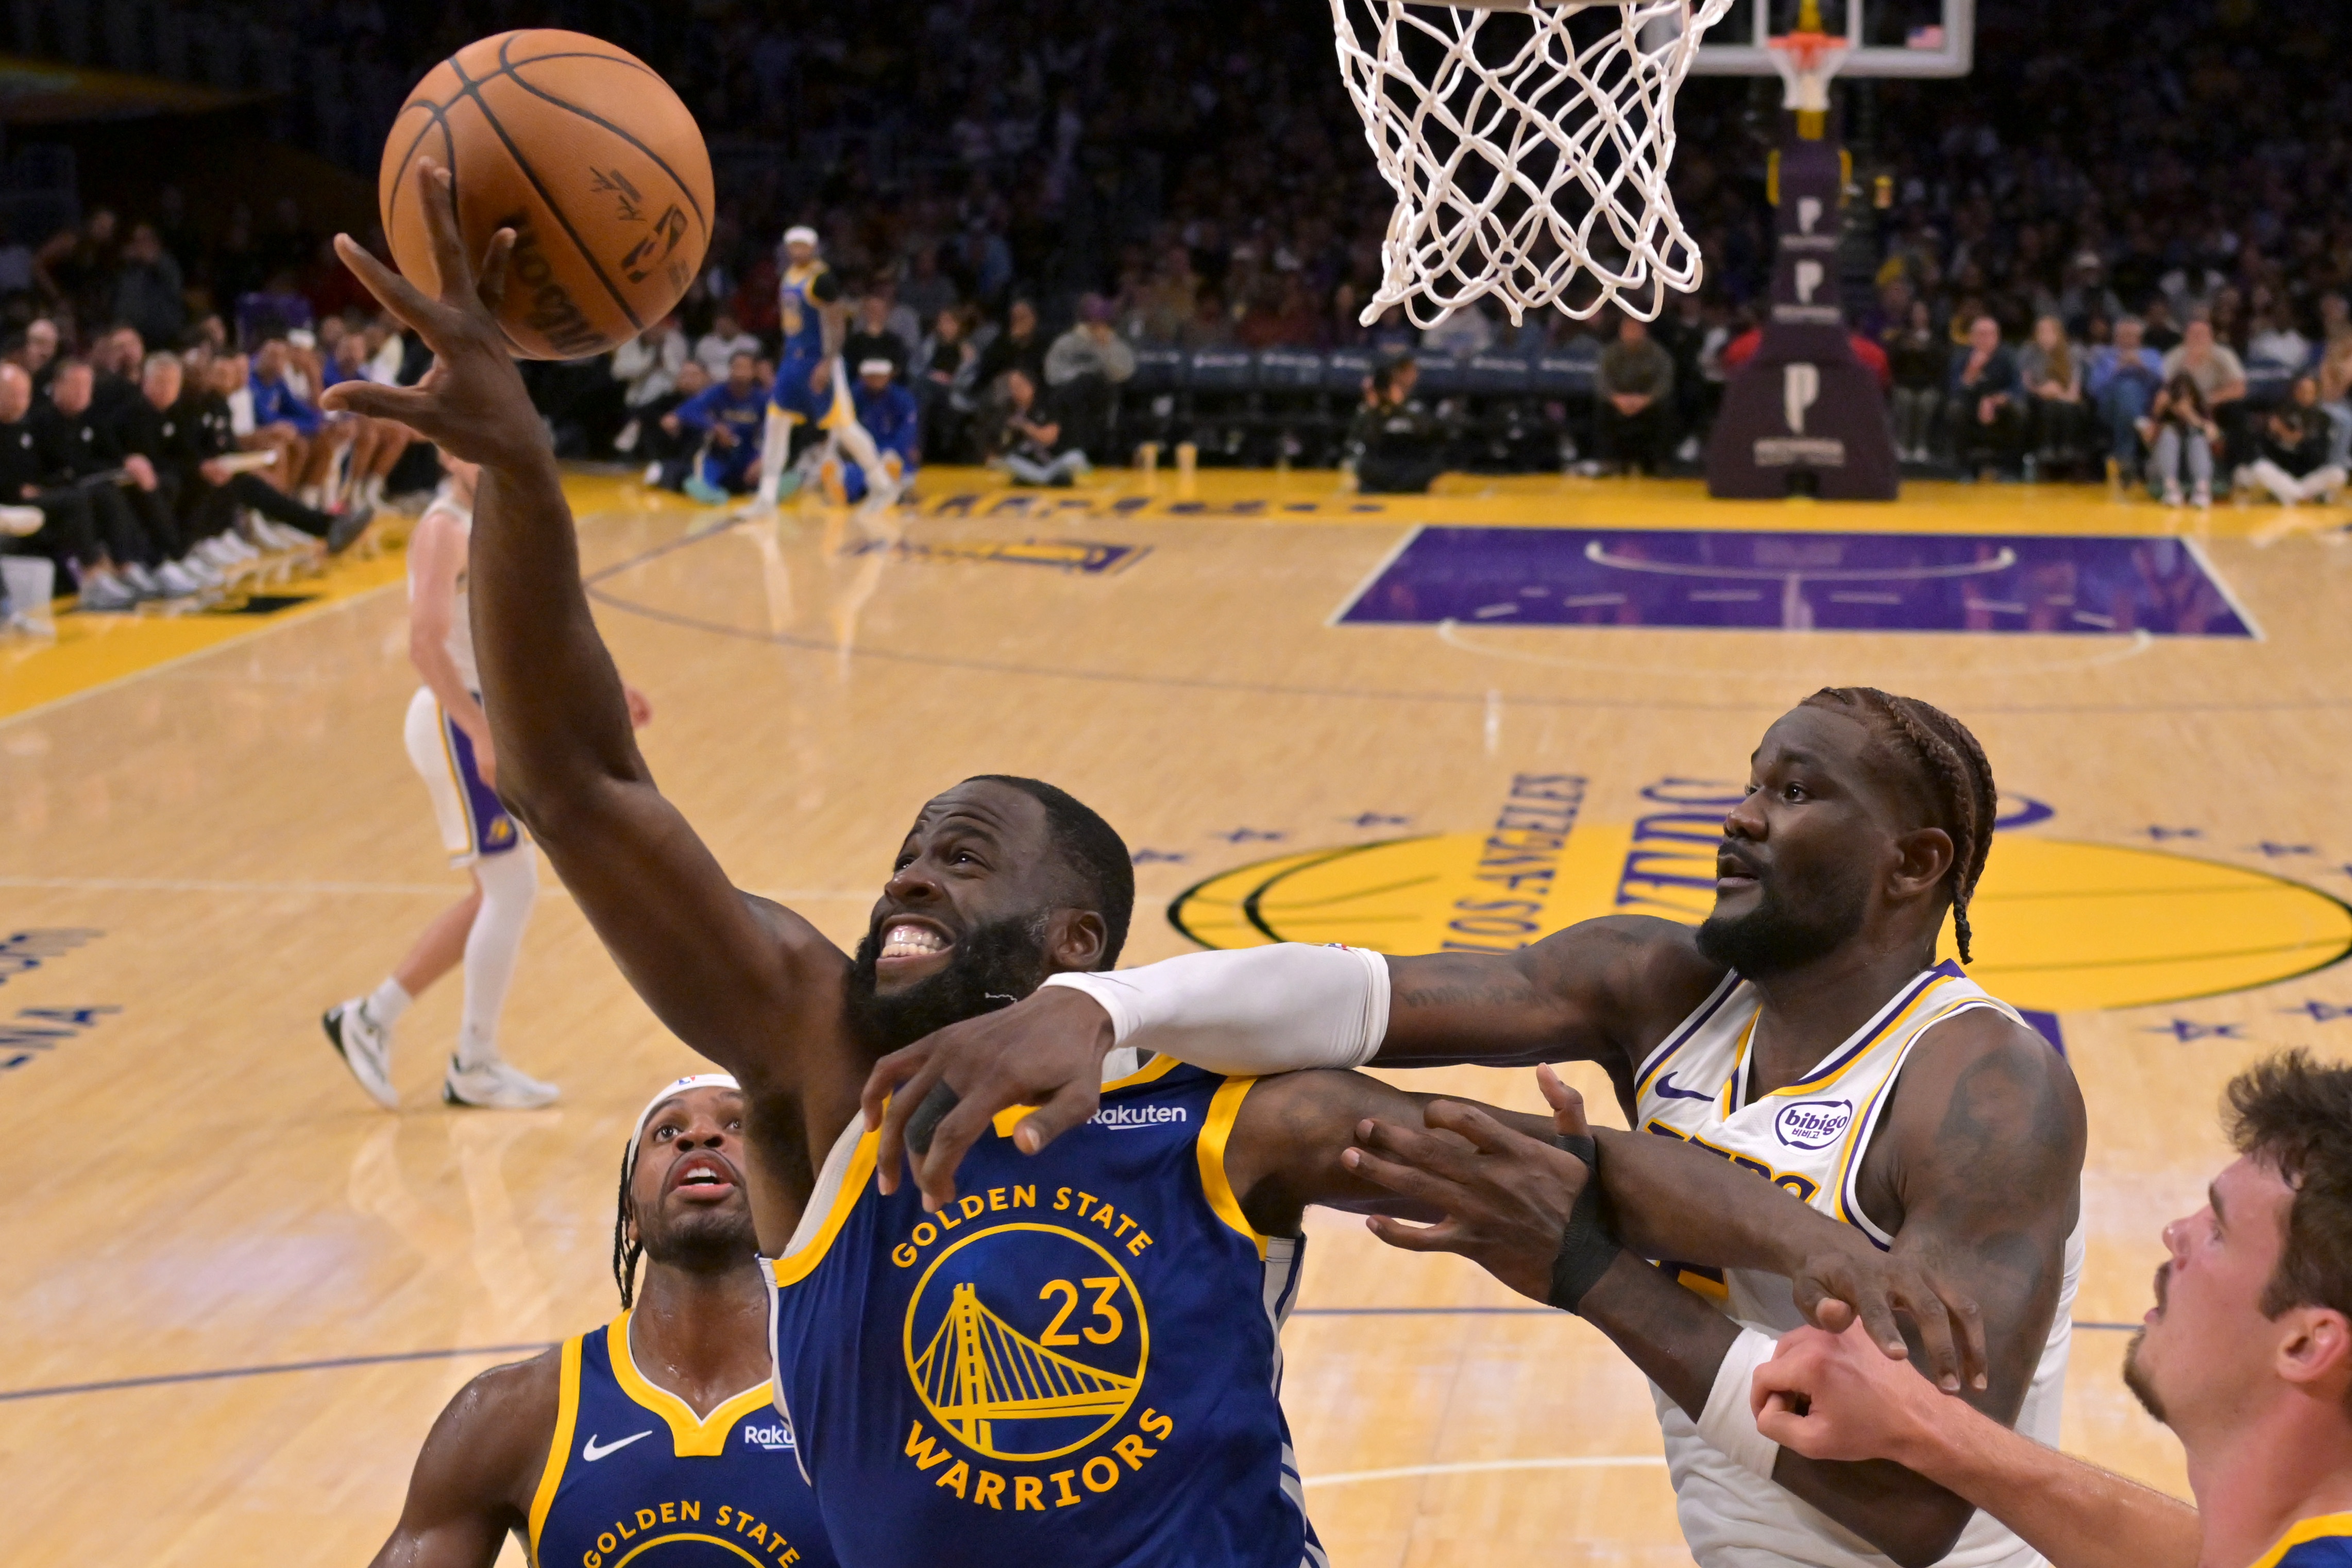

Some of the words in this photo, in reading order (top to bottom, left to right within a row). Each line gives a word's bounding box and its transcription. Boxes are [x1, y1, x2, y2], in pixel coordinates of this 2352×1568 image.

[1784, 1109, 1848, 1135] bibigo
[1791, 1128, 1820, 1139] 비비고
[891, 1185, 1036, 1268] GOLDEN
[1054, 1187, 1154, 1257] STATE
[1039, 1276, 1123, 1346] 23
[904, 1408, 1174, 1511] WARRIORS
[583, 1501, 700, 1568] GOLDEN
[716, 1505, 800, 1568] STATE
